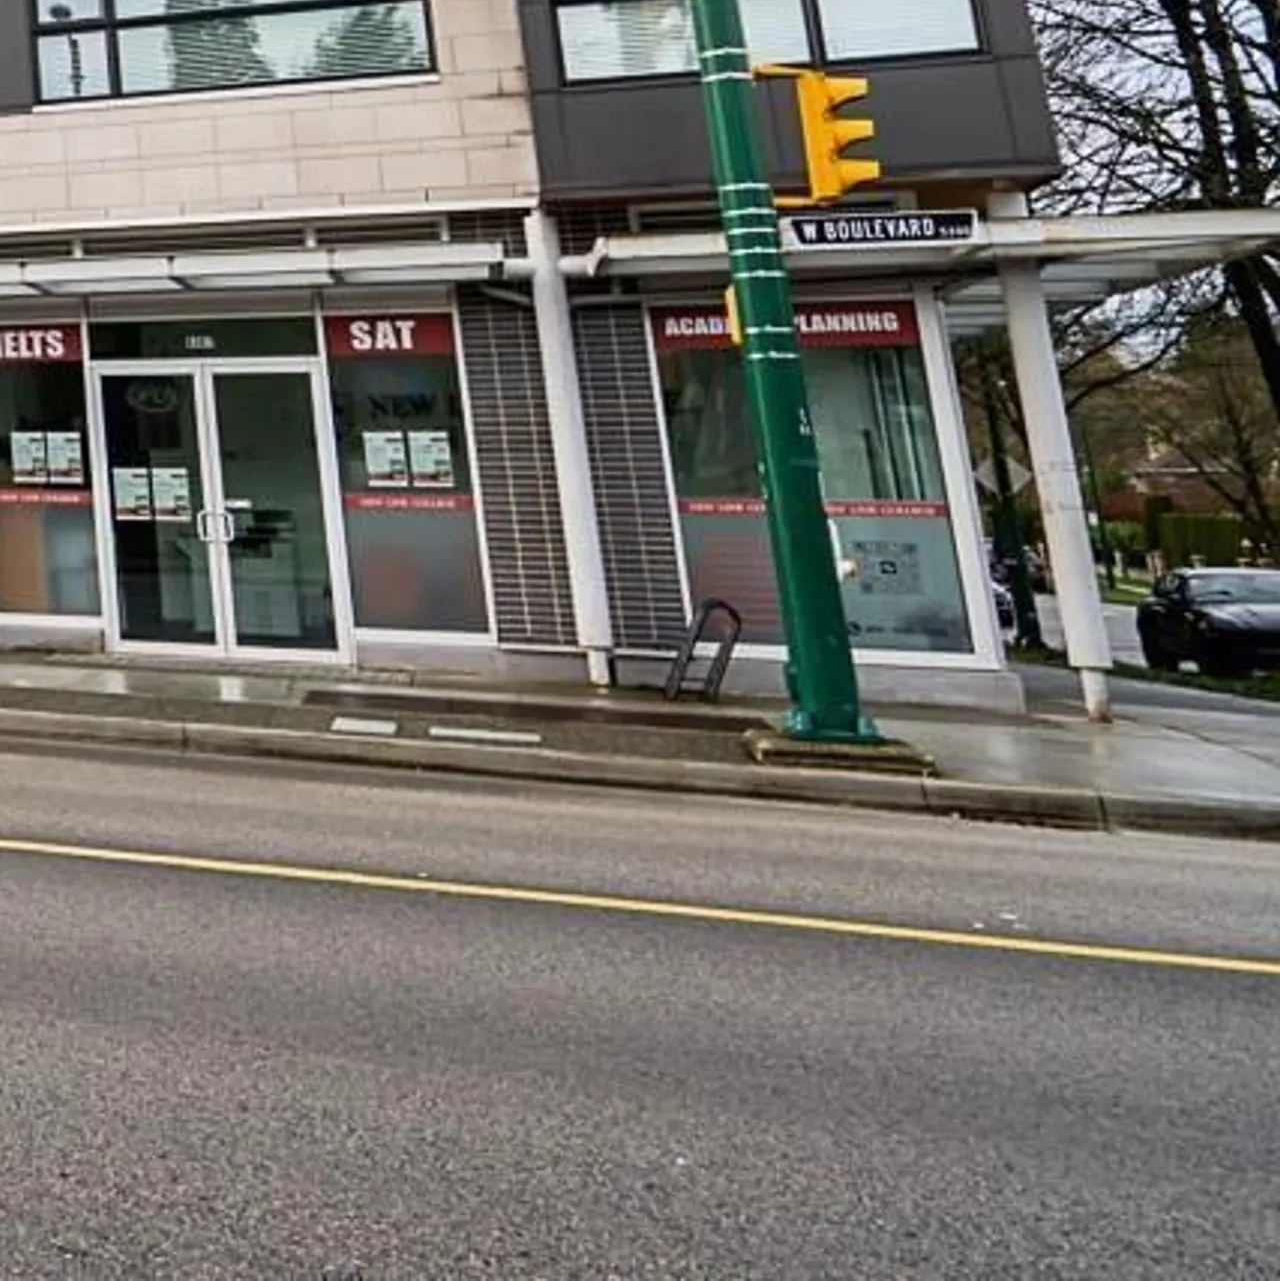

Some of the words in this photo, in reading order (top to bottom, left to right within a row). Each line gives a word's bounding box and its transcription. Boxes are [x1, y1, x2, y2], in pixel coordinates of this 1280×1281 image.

[802, 221, 819, 241] W
[823, 218, 936, 241] BOULEVARD
[349, 319, 417, 352] SAT
